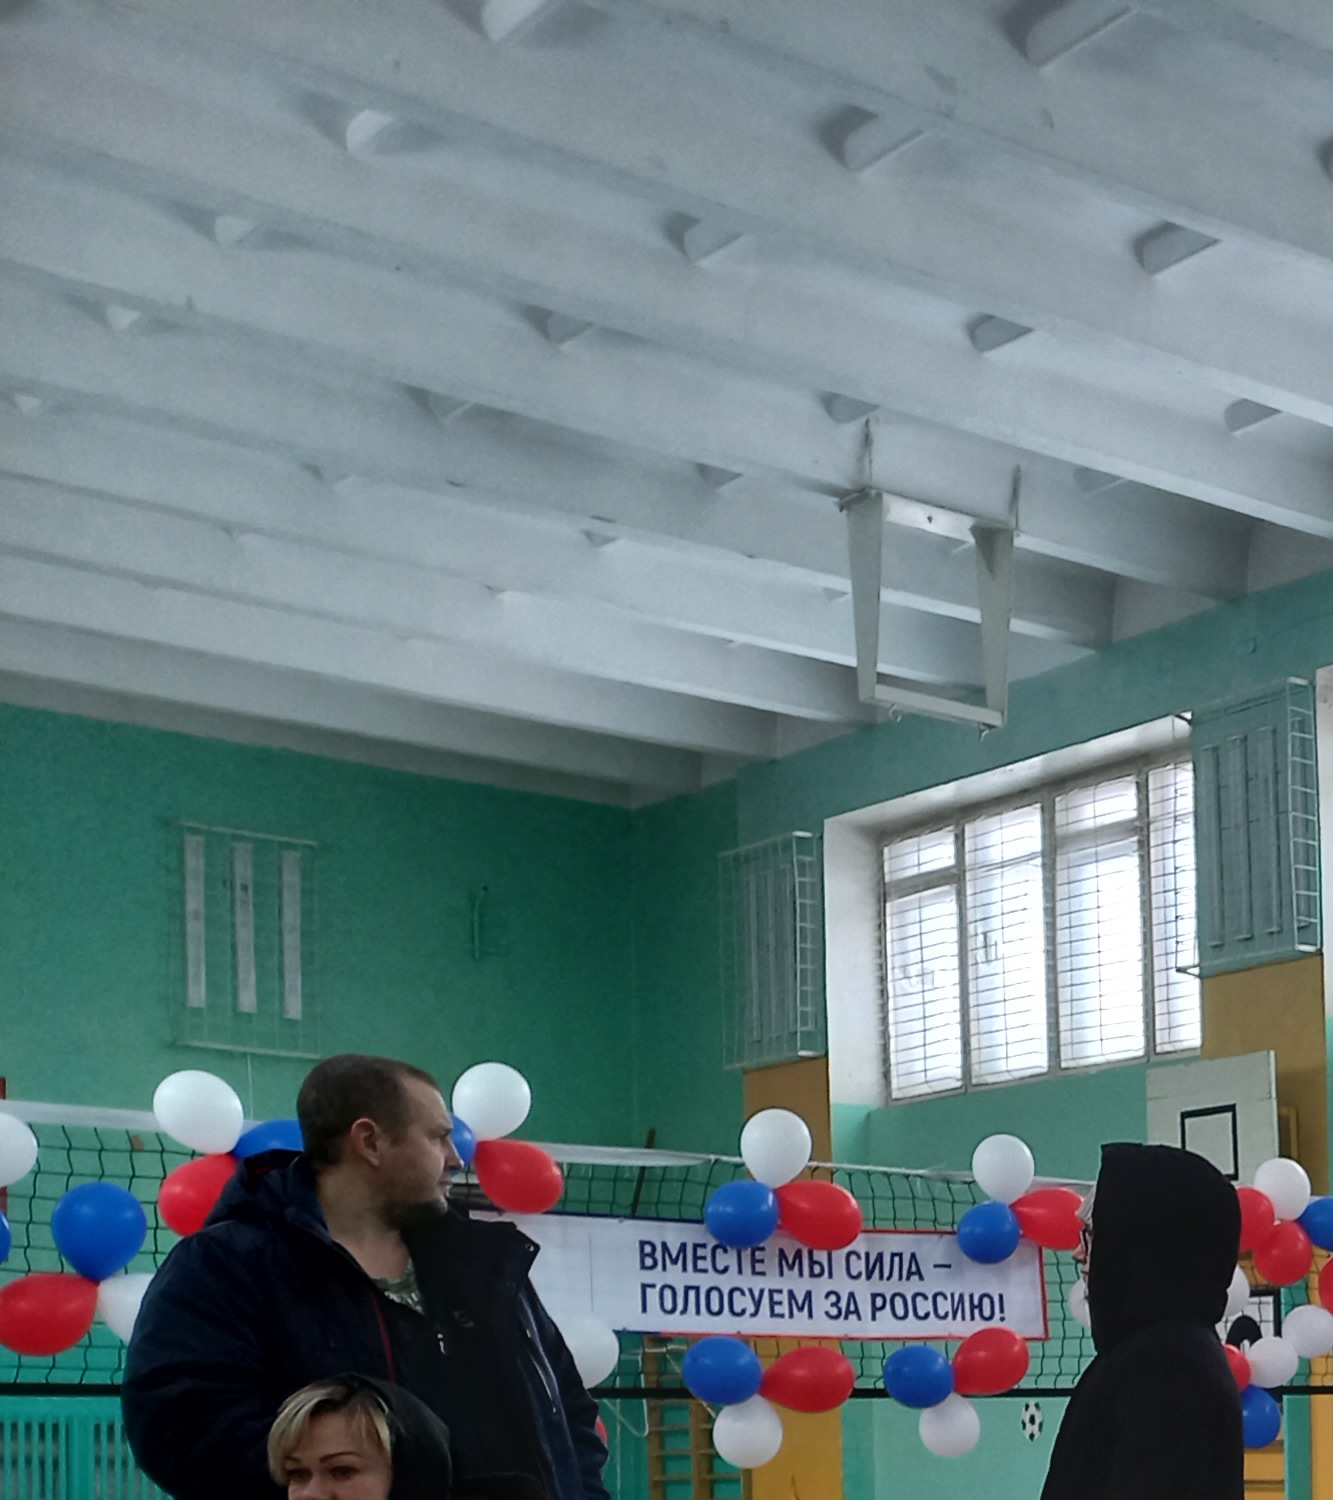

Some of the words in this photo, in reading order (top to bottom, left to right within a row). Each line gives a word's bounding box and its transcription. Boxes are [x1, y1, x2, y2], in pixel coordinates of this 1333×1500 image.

[638, 1239, 767, 1277] ВМЕСТЕ
[778, 1246, 833, 1280] МЫ
[844, 1250, 925, 1282] СИЛА
[640, 1282, 813, 1320] ГОЛОСУЕМ
[823, 1289, 862, 1321] ЗА
[870, 1290, 1006, 1323] РОССИЮ!
